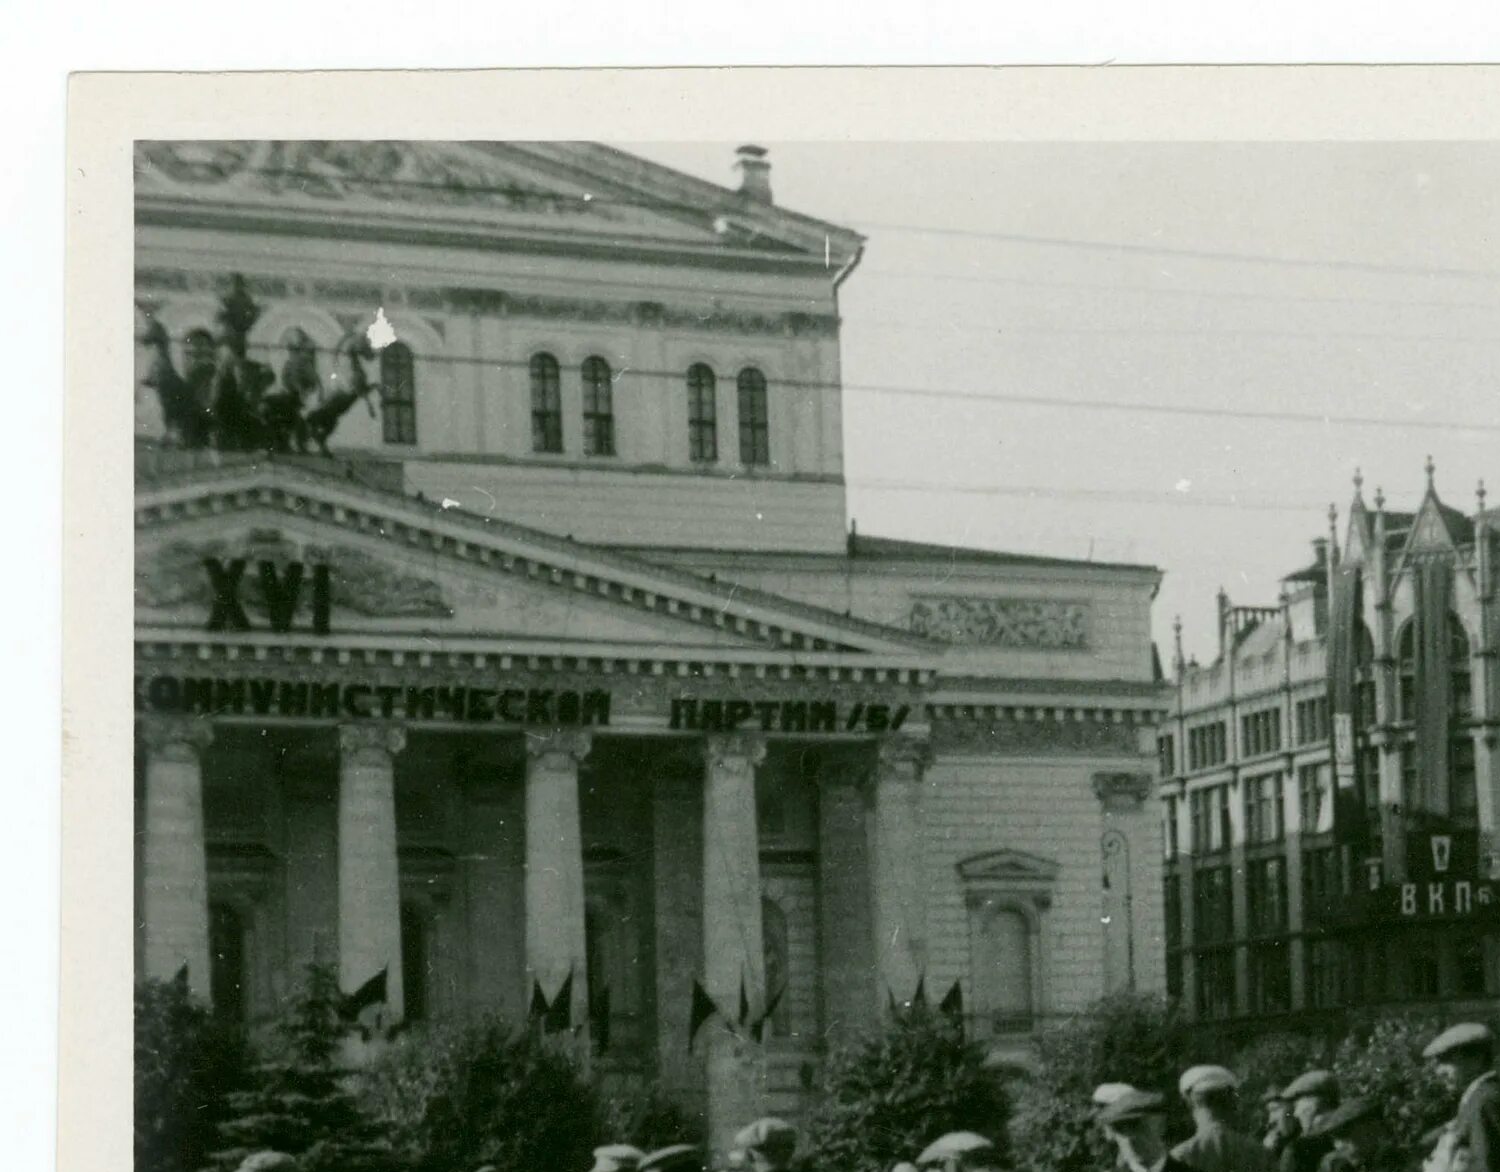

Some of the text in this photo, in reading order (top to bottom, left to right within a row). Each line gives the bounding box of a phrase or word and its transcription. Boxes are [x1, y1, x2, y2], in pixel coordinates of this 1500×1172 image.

[201, 557, 331, 634] XVI
[136, 676, 611, 727] ОММУНИСТИЧЕСКОЙ
[671, 697, 837, 732] ПАРТИИ
